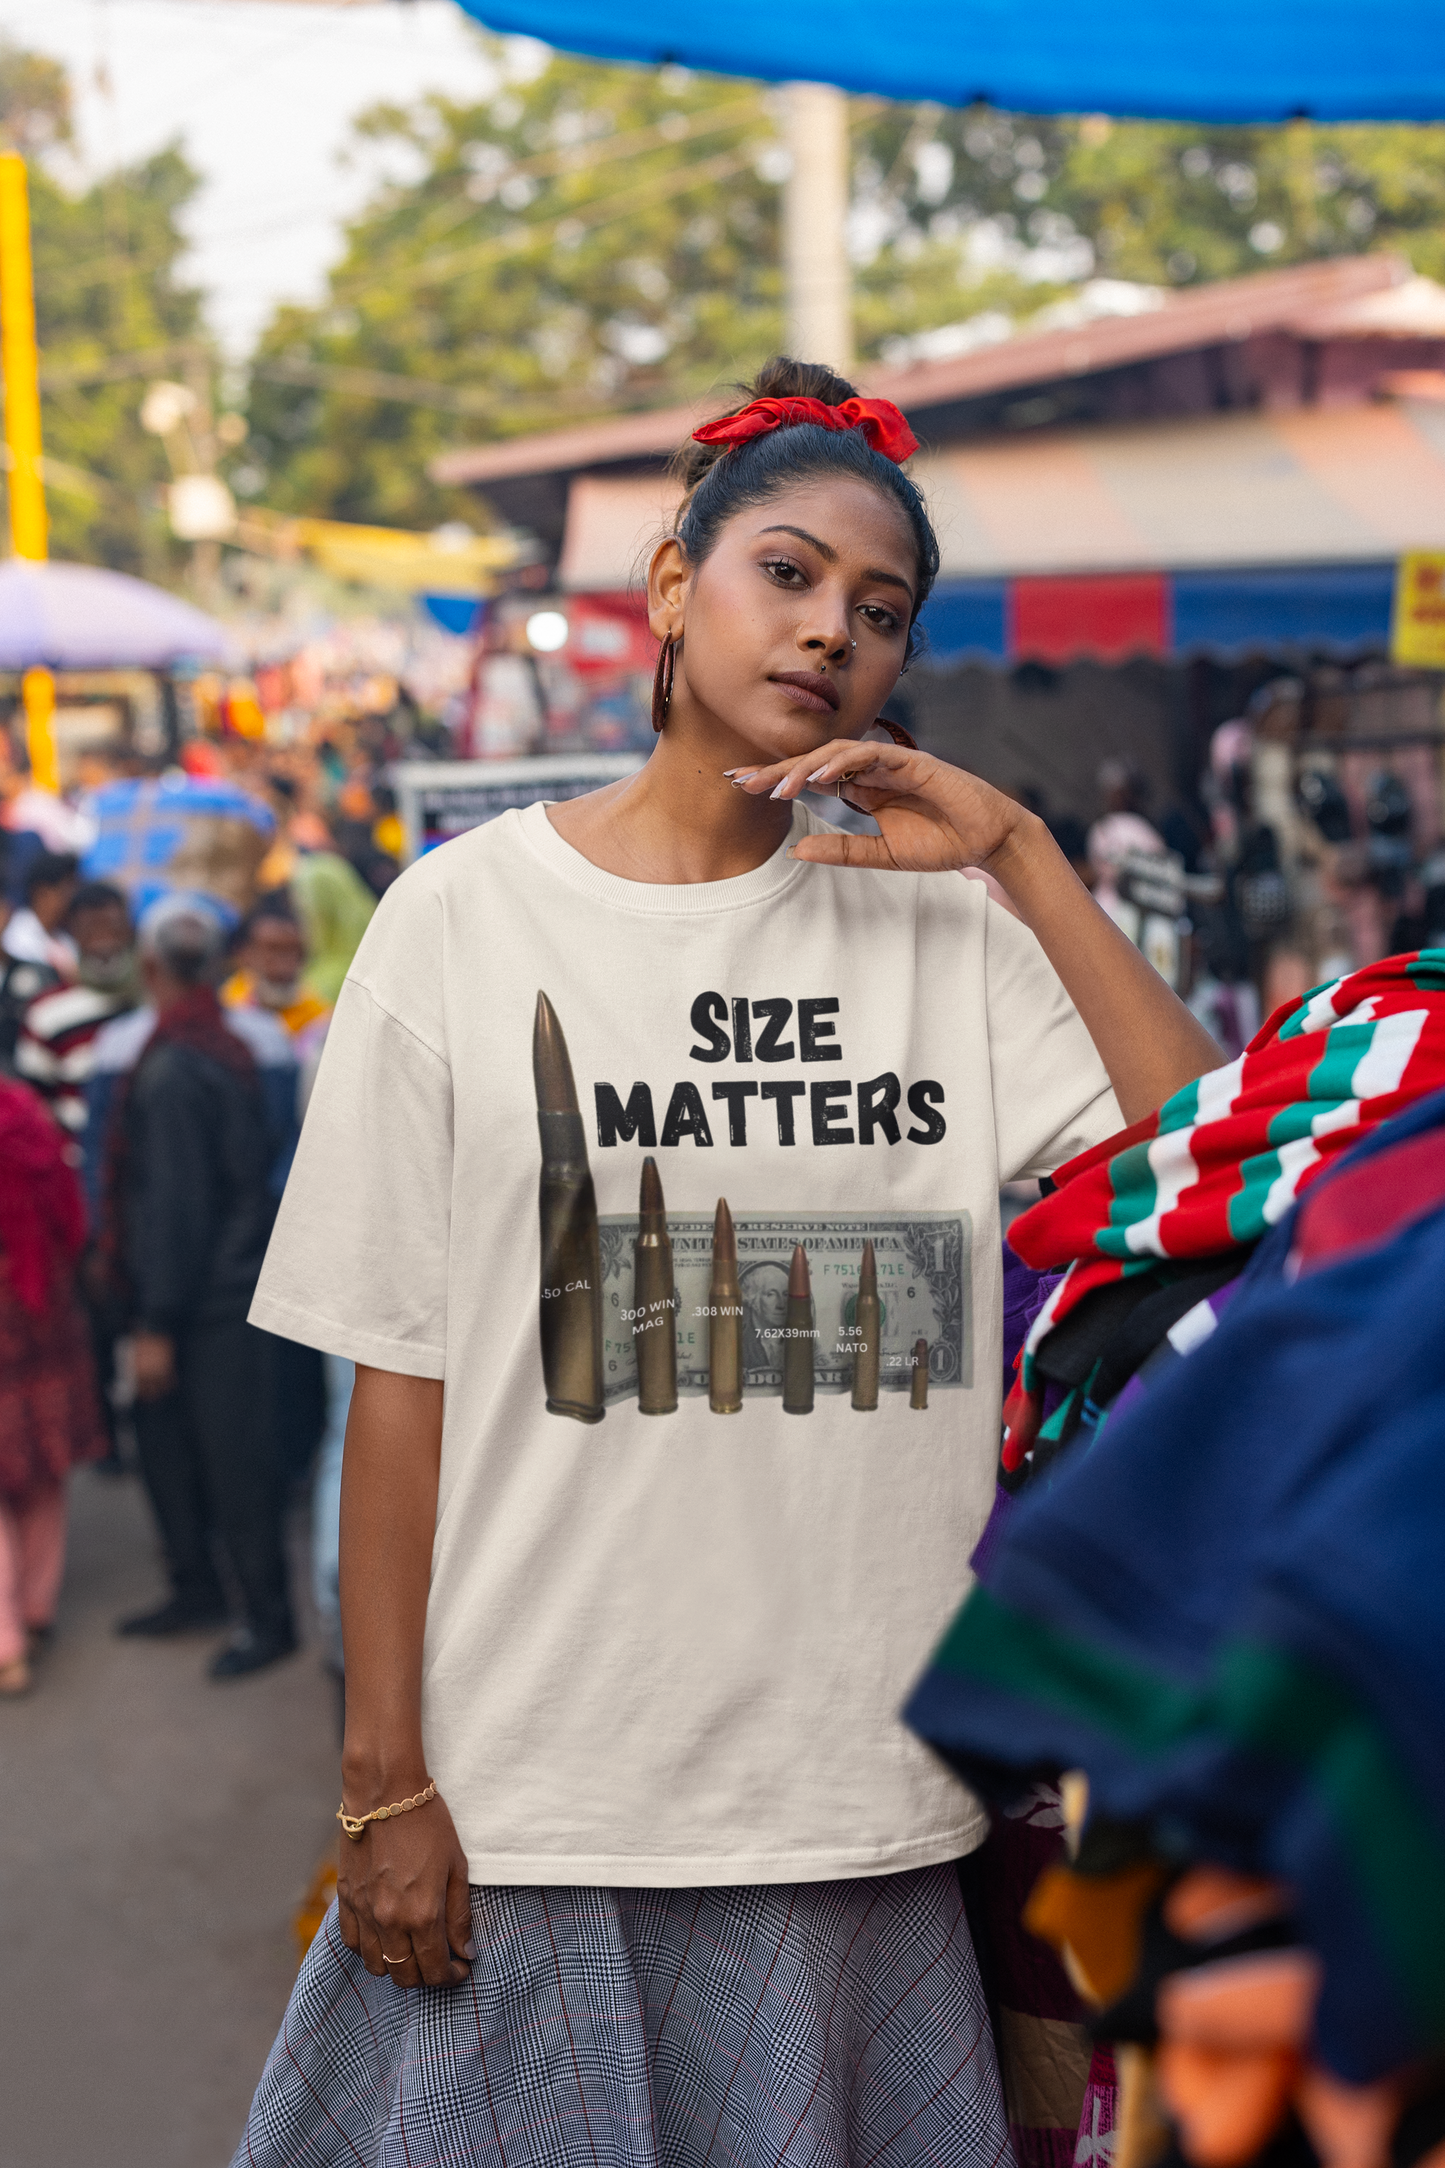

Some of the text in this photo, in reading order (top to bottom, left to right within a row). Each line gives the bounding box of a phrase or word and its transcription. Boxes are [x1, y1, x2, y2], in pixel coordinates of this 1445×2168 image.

[689, 991, 843, 1063] SIZE
[594, 1071, 947, 1147] MATTERS
[748, 1223, 823, 1231] RESERVE
[825, 1223, 868, 1231] NOTE
[738, 1237, 799, 1250] STATES
[802, 1237, 824, 1250] OF
[541, 1279, 591, 1299] .50 CAL
[620, 1298, 675, 1321] 300 WIN
[692, 1306, 744, 1316] .308 WIN
[632, 1316, 664, 1335] MAG
[838, 1326, 863, 1336] 5.56
[754, 1328, 820, 1338] 7.62X39mm
[836, 1343, 868, 1353] NATO
[886, 1357, 919, 1367] .22 LR
